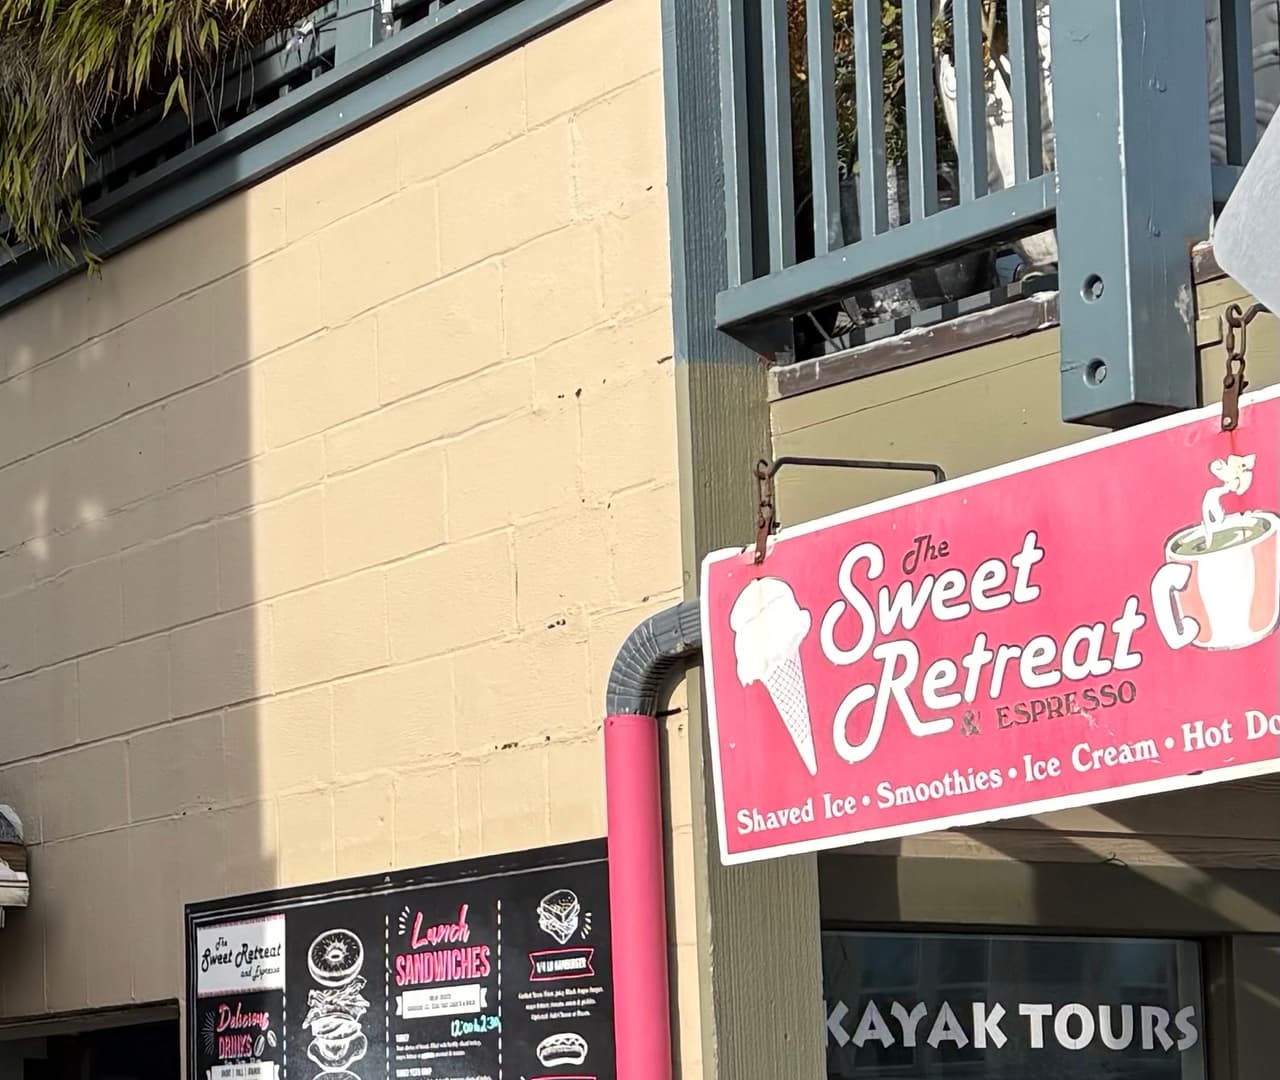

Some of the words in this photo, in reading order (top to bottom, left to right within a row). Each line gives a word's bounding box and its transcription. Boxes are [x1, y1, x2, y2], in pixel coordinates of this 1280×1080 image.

[903, 535, 950, 575] The
[820, 531, 1045, 666] Sweet
[833, 596, 1146, 763] Retreat
[961, 711, 981, 736] &
[996, 681, 1138, 730] ESPRESSO
[737, 796, 814, 835] Shaved
[823, 791, 857, 820] Ice
[876, 768, 1003, 809] Smoothies
[1023, 752, 1062, 782] Ice
[1071, 740, 1159, 774] Cream
[1182, 716, 1233, 751] Hot
[411, 904, 471, 949] Lunch
[202, 948, 233, 972] Sweet
[235, 943, 281, 968] Retreat
[396, 946, 491, 986] SANDWICHES
[216, 1002, 270, 1032] Delicious
[824, 1001, 1007, 1050] KAYAK
[1018, 1003, 1199, 1053] TOURS
[218, 1034, 252, 1059] DRINKS
